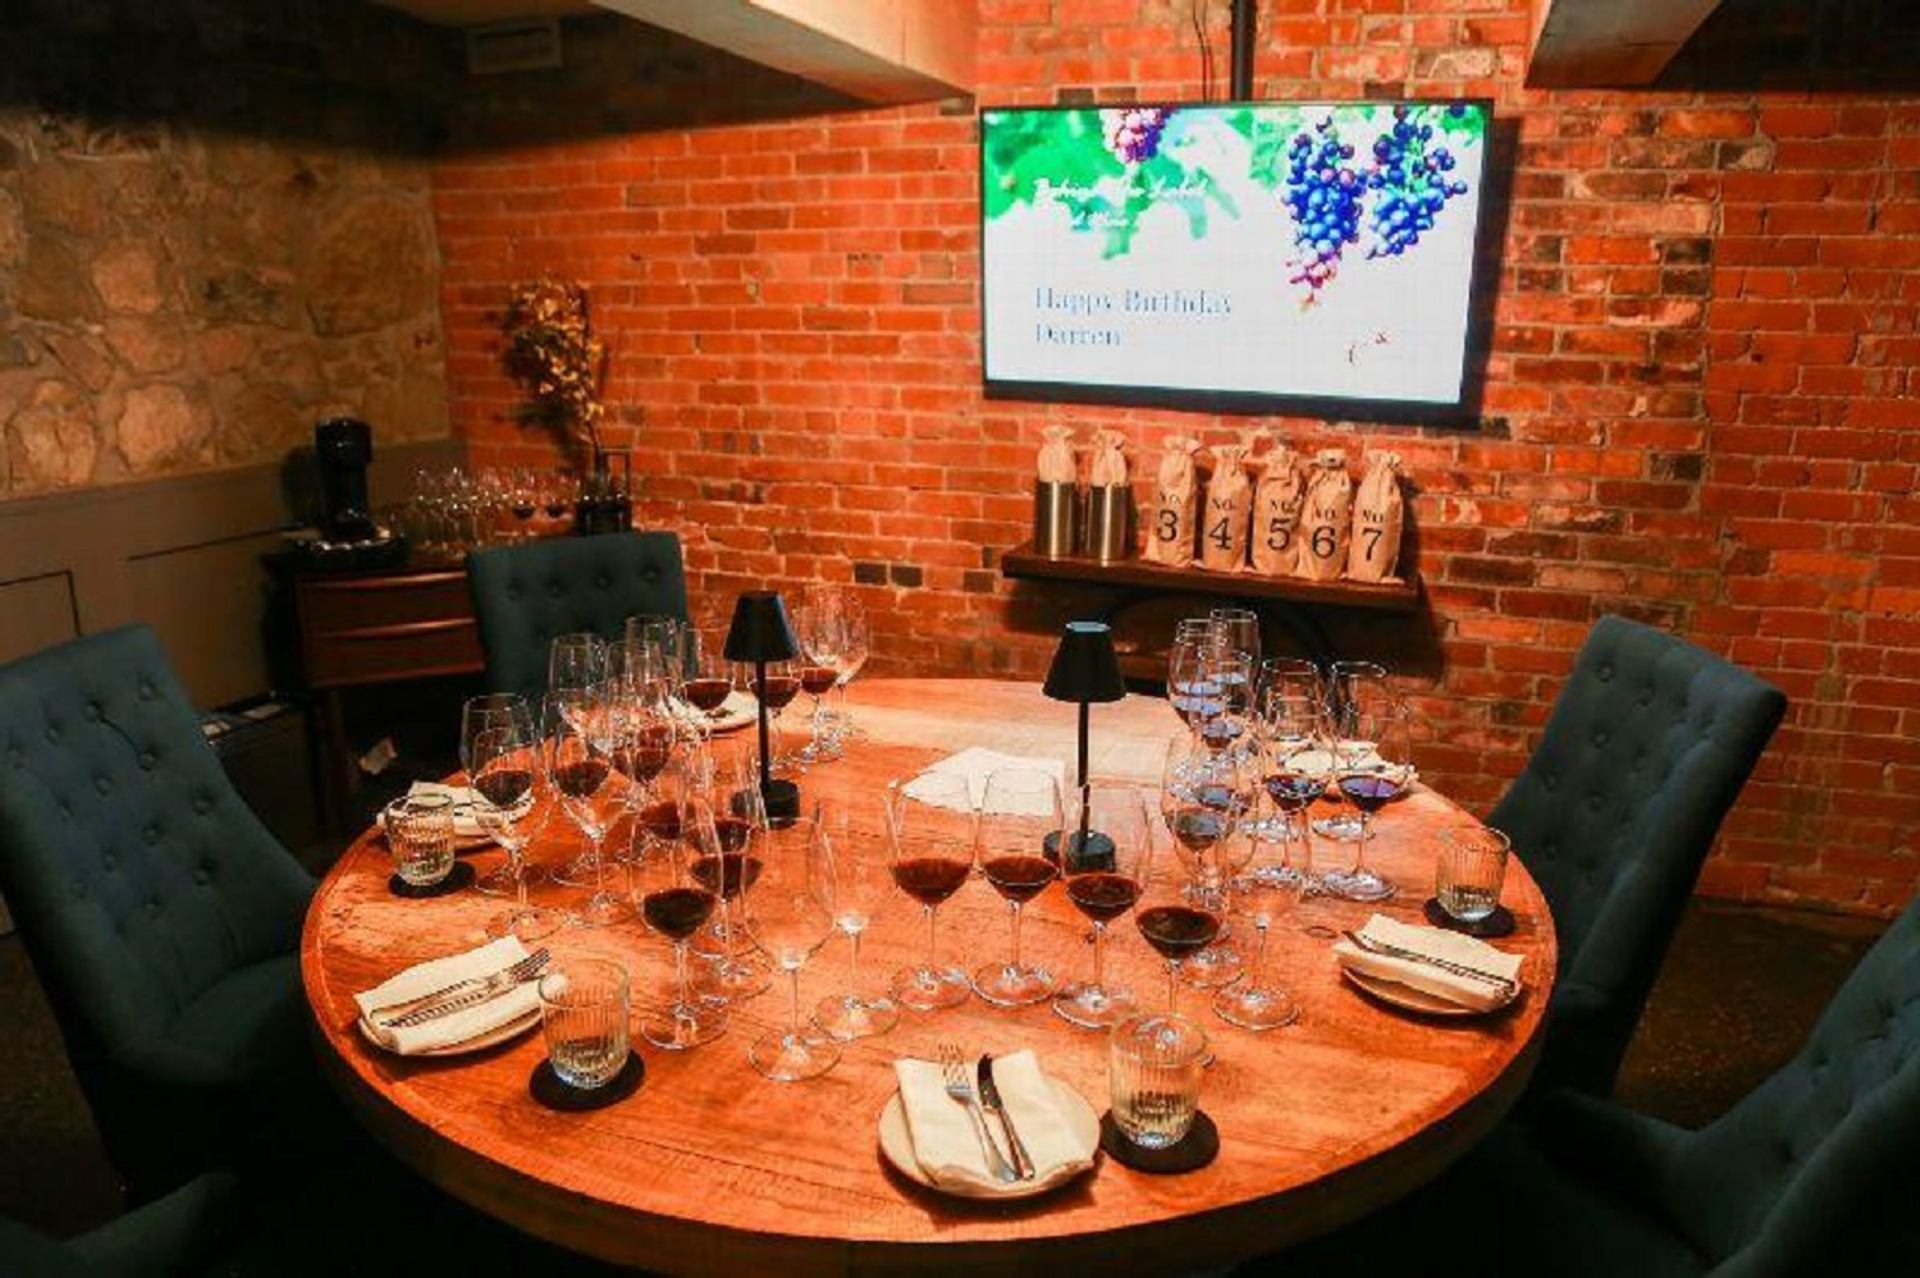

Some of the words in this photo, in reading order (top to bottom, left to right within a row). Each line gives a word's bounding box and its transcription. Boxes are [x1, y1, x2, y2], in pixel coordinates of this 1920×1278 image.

[1036, 287, 1111, 315] Happy
[1124, 289, 1231, 317] Birthday
[1036, 323, 1121, 346] Darren
[1157, 509, 1177, 542] 3
[1209, 517, 1232, 550] 4
[1267, 518, 1290, 551] 5
[1312, 525, 1336, 559] 6
[1362, 527, 1383, 561] 7
